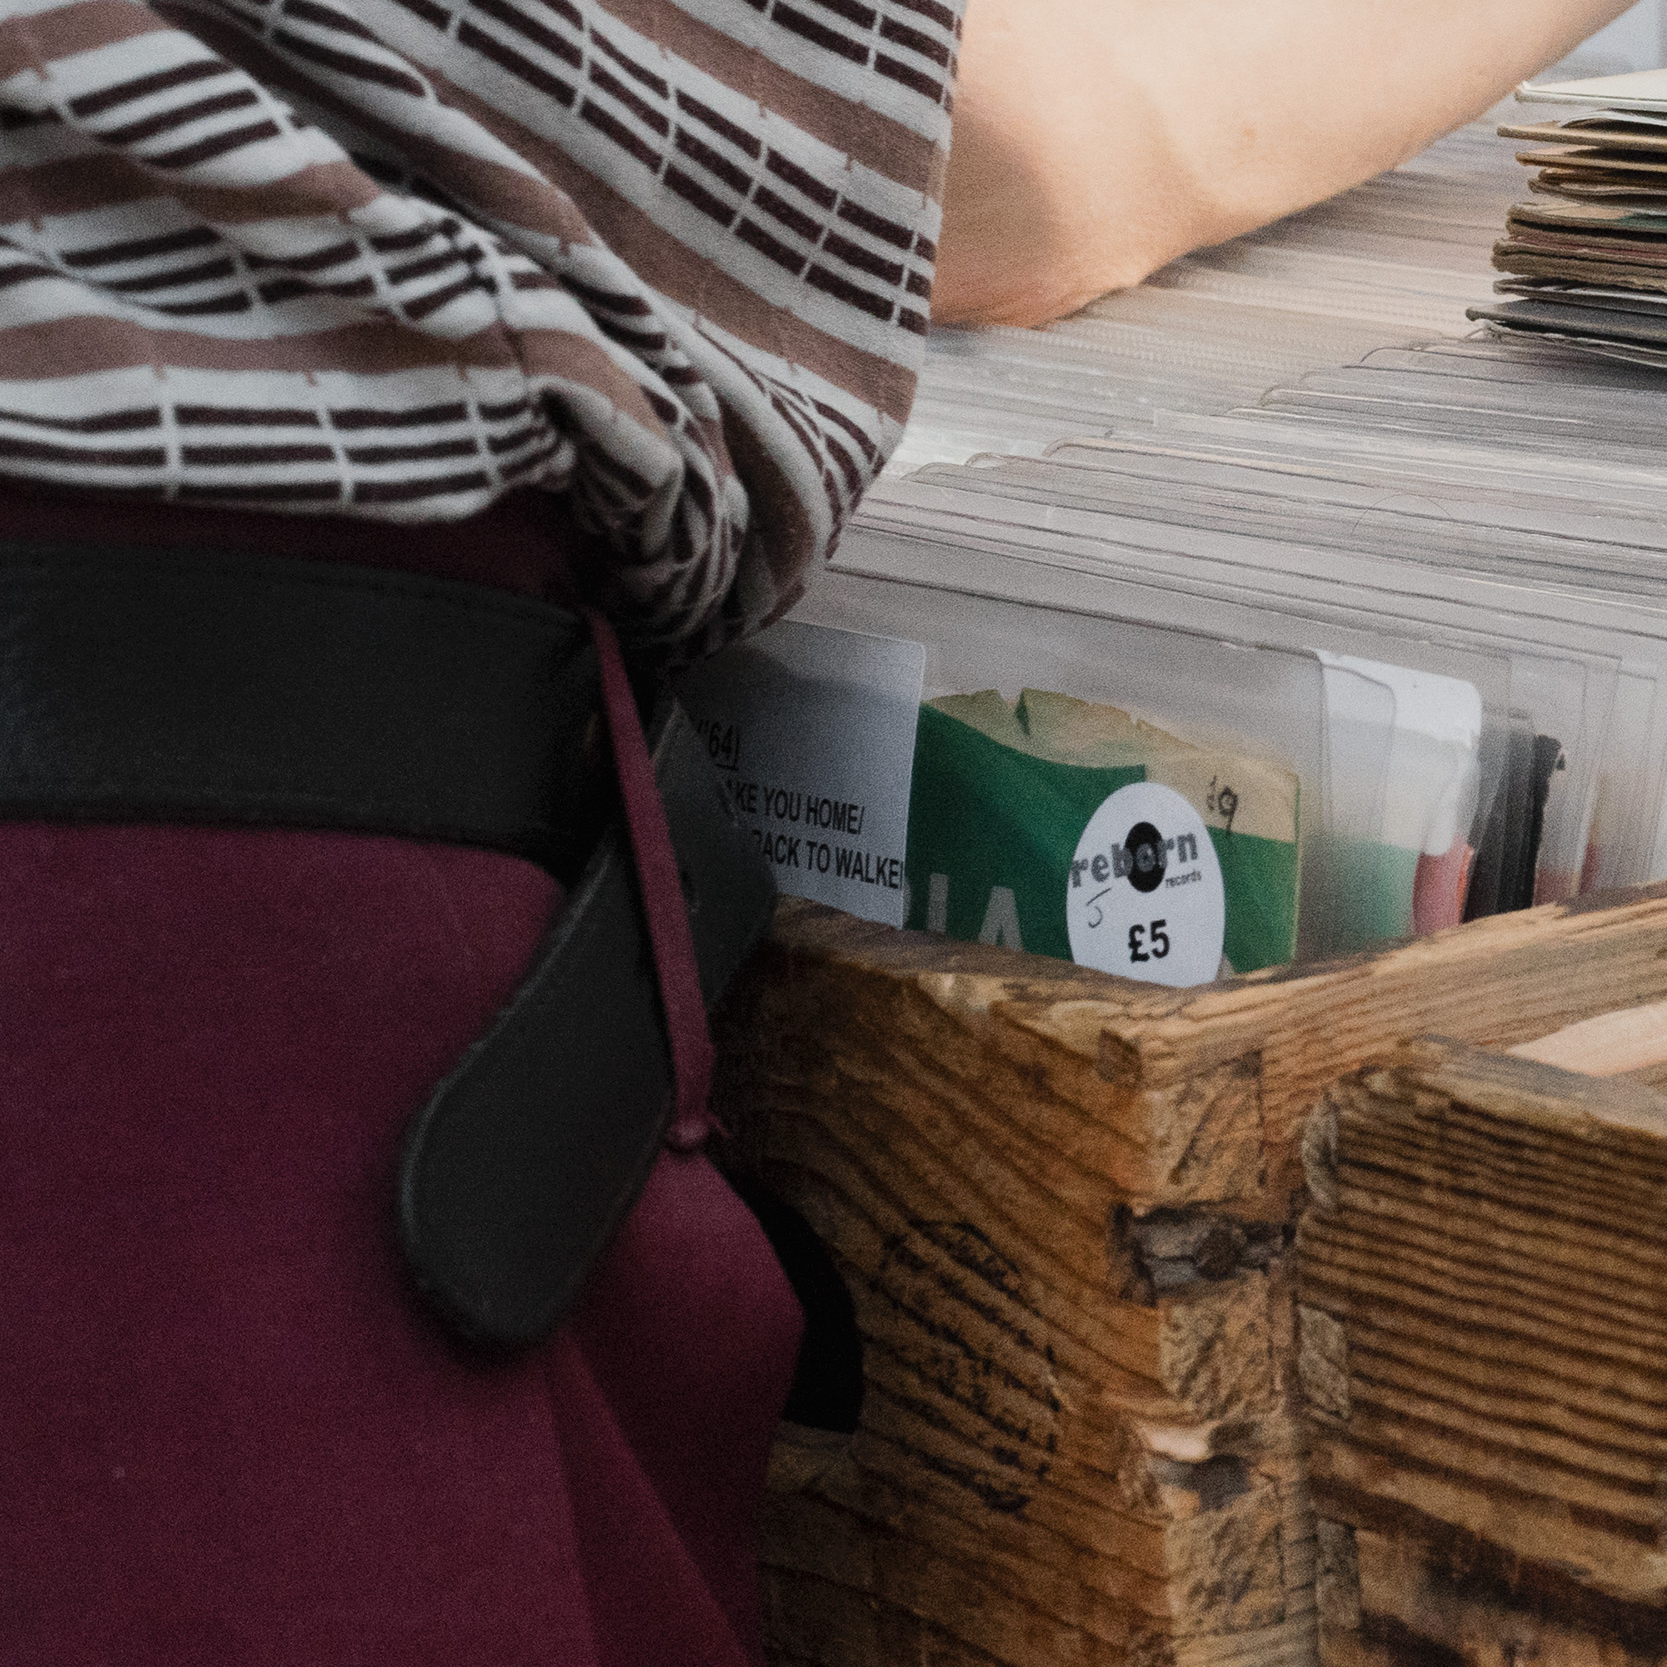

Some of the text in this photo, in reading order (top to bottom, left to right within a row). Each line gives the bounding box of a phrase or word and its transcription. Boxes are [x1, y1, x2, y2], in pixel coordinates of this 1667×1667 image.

[727, 779, 758, 815] KE
[763, 786, 801, 822] YOU
[806, 839, 832, 875] TO
[834, 846, 904, 891] WALKE
[1164, 868, 1203, 890] records
[1127, 917, 1171, 964] £5
